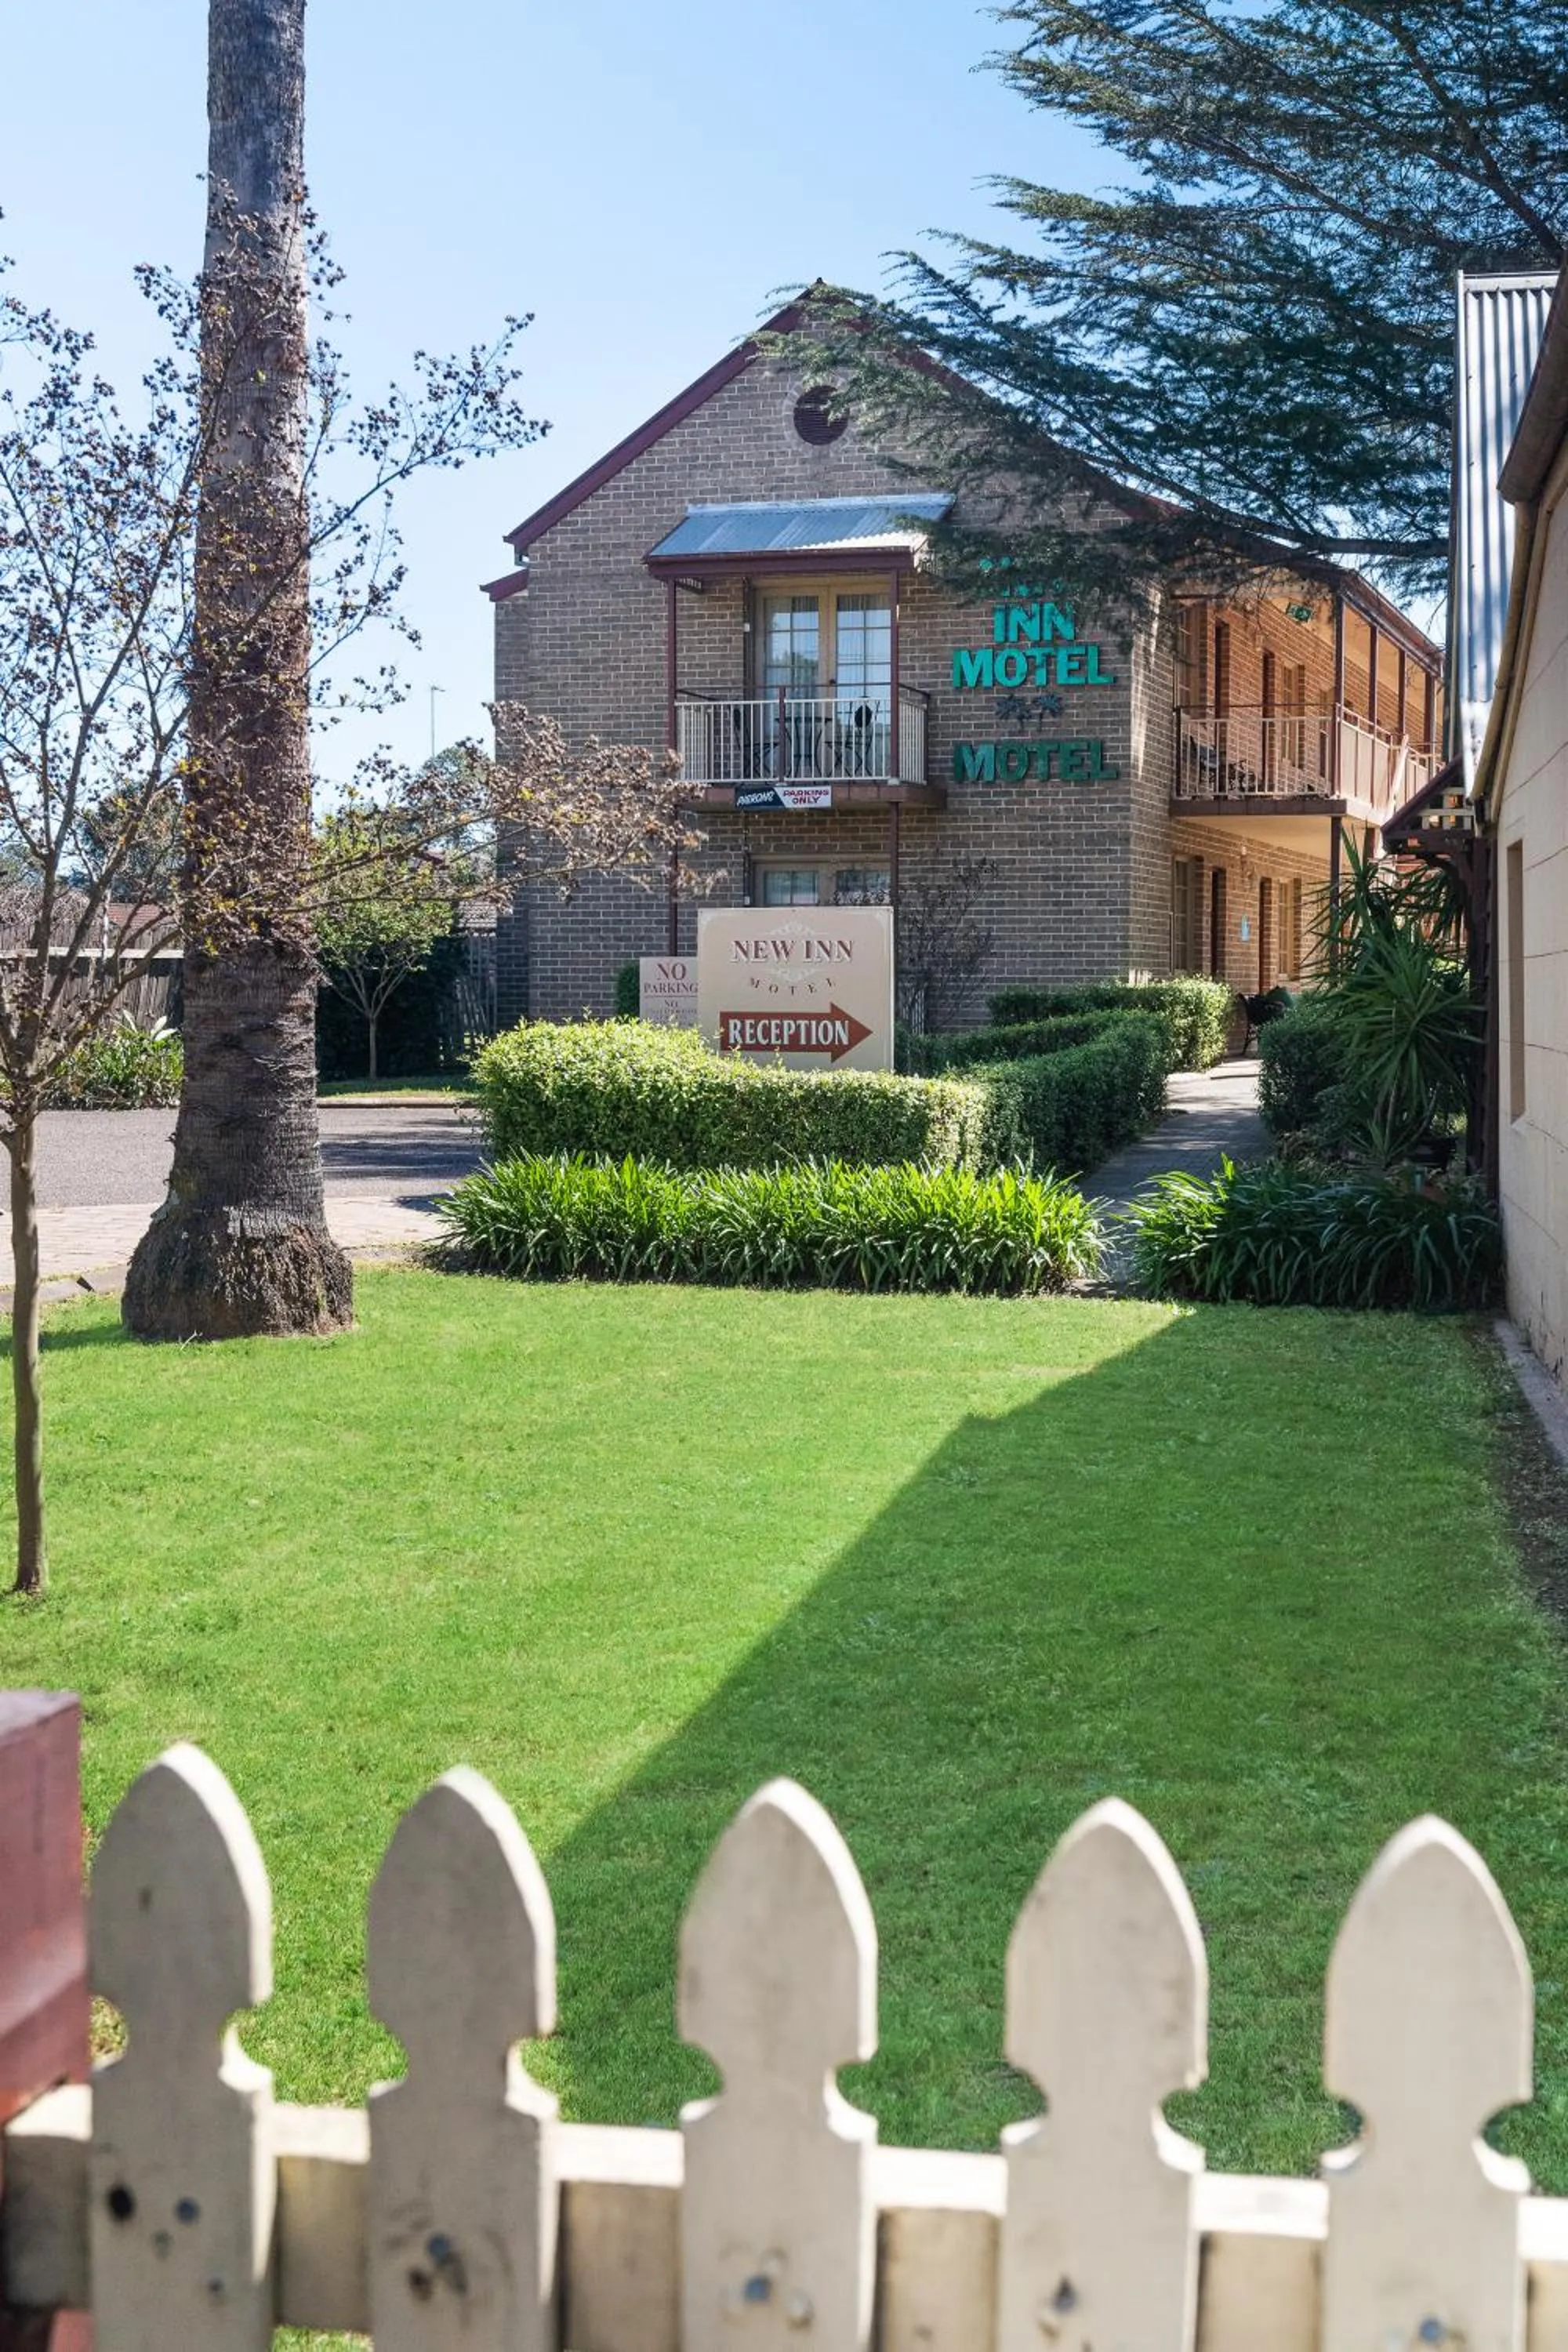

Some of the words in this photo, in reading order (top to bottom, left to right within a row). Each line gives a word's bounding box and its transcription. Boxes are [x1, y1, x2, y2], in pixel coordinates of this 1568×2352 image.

[993, 602, 1076, 643] INN
[953, 646, 1115, 688] MOTEL
[953, 739, 1119, 782] MOTEL
[730, 940, 796, 963] NEW
[801, 940, 854, 963] INN
[656, 963, 686, 980] NO
[644, 982, 699, 993] PARKING
[750, 978, 837, 995] MOTEL
[728, 1019, 849, 1046] RECEPTION
